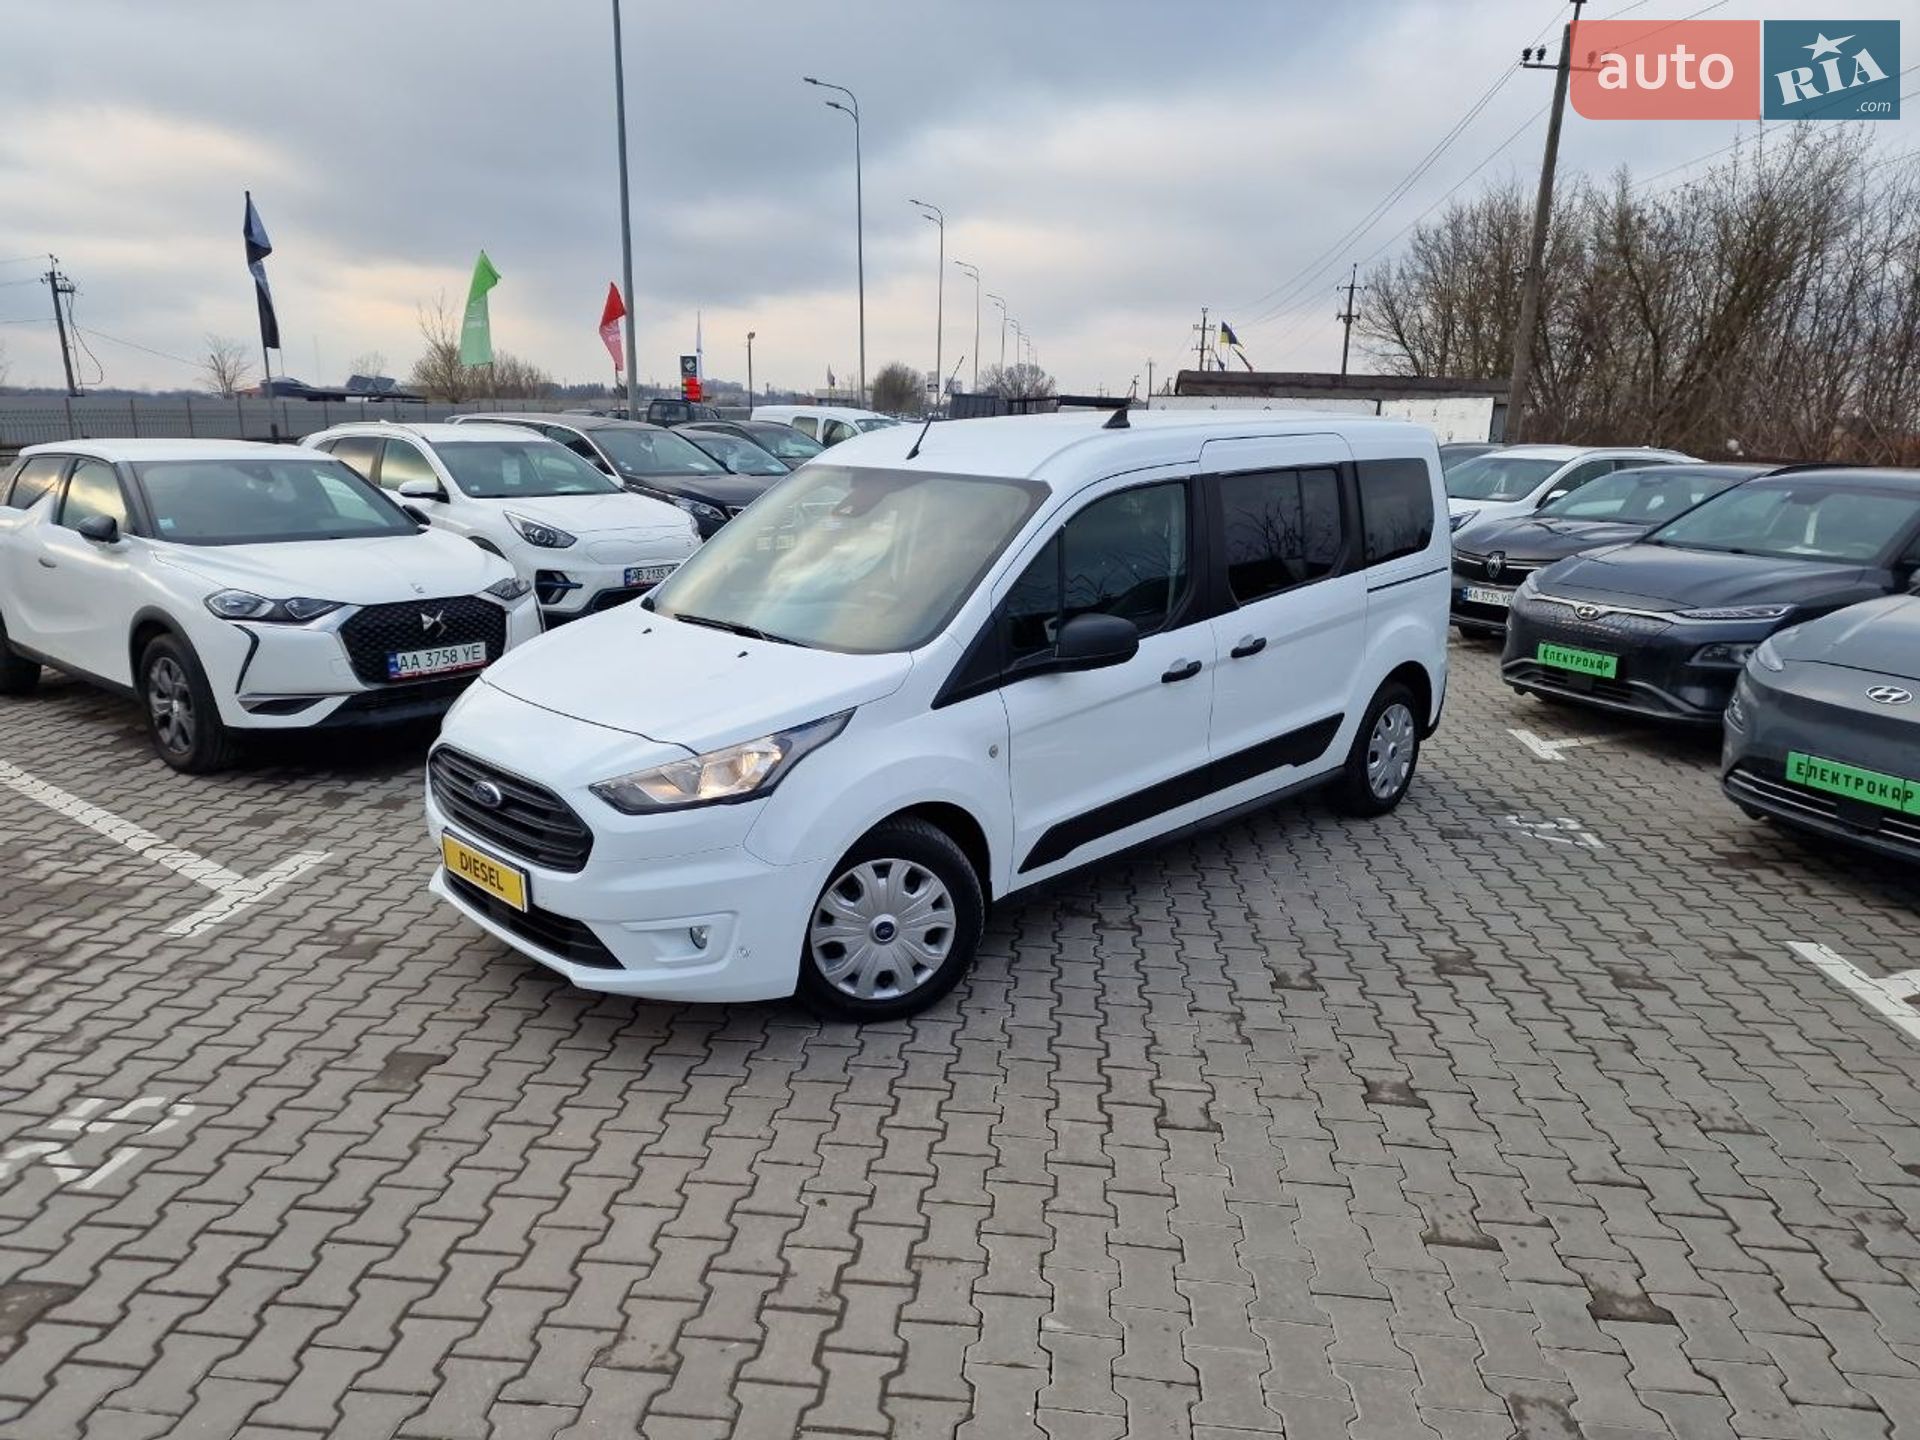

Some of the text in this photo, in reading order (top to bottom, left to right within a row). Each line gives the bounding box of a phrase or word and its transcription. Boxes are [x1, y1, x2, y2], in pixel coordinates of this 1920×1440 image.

[400, 644, 481, 670] AA 3758 YE
[1543, 648, 1610, 671] ЕЛЕКТРОКАР
[1795, 761, 1915, 803] ЕЛЕКТРОКАР
[459, 850, 504, 892] DIESEL
